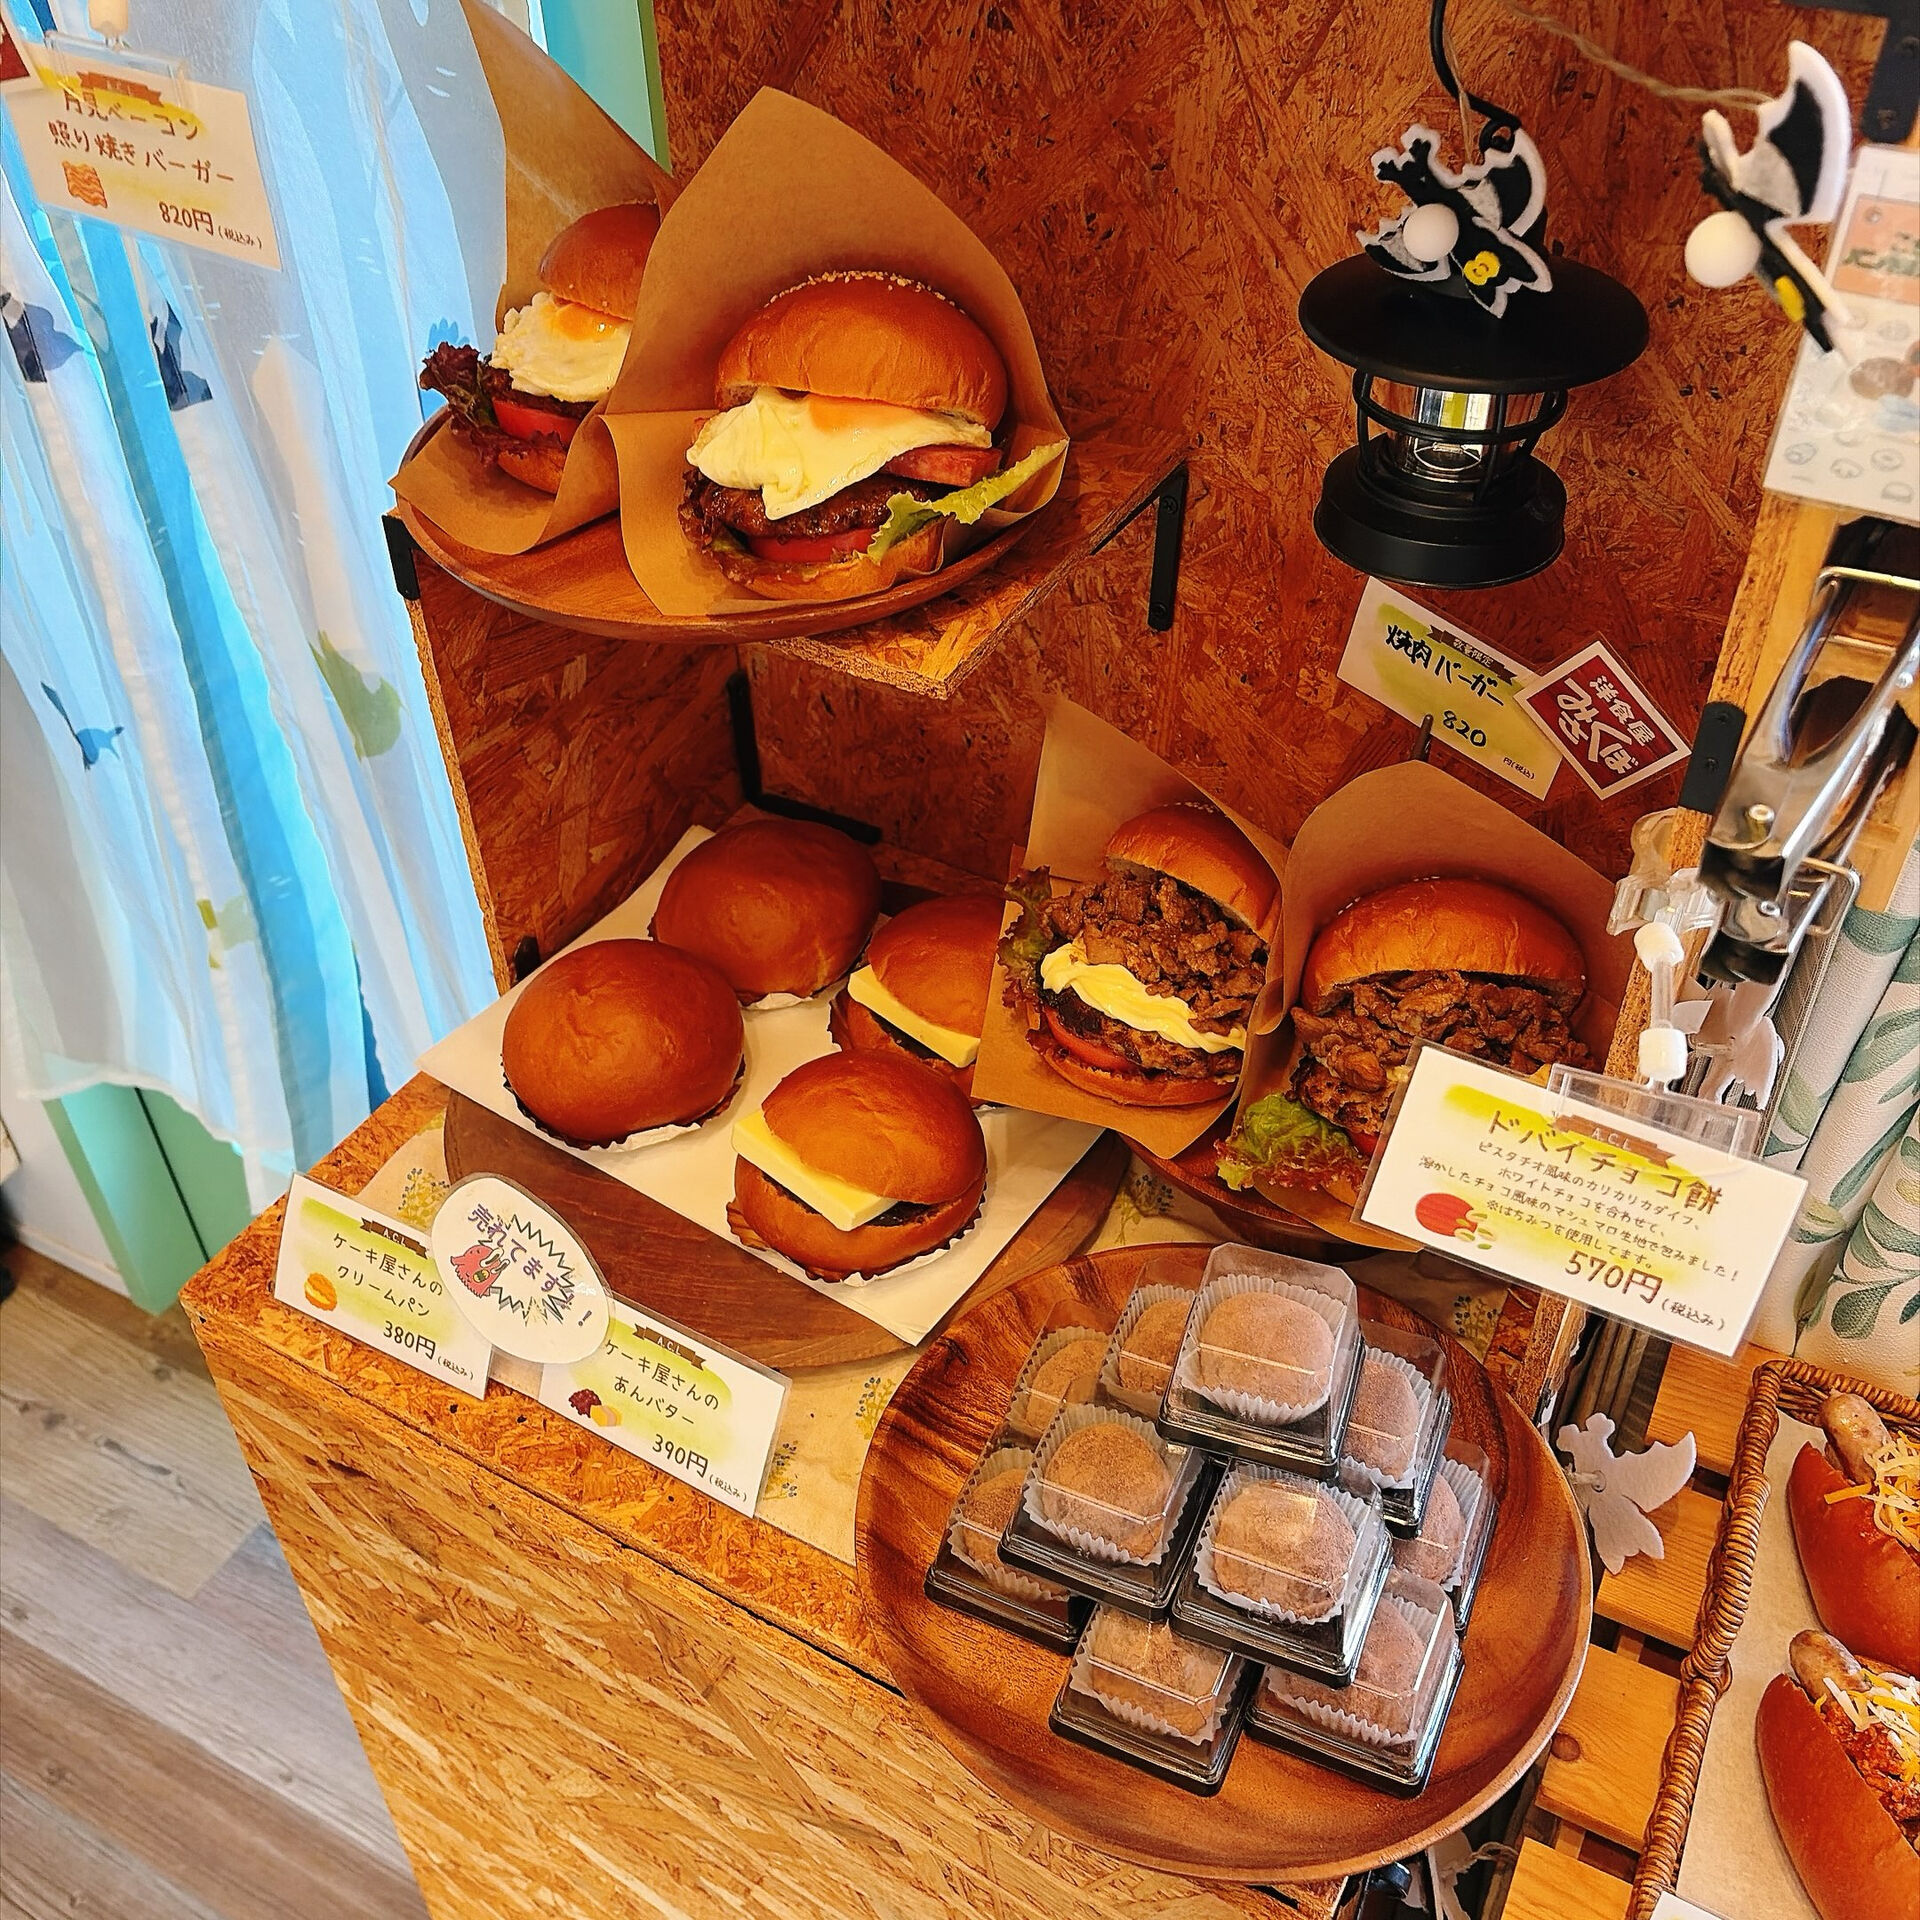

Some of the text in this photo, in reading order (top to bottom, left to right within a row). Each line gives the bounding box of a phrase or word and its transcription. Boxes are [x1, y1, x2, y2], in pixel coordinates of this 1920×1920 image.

[159, 201, 214, 236] 820円
[1385, 624, 1504, 706] 焼肉バーガー
[1440, 709, 1487, 748] 820
[1590, 675, 1656, 746] 洋食屋
[1487, 1110, 1723, 1216] ドバイチョコ餅
[1498, 1167, 1666, 1238] ホワイトチョコを合わせて、
[332, 1232, 443, 1297] ケーキ屋さんの
[1565, 1251, 1663, 1304] 570円
[336, 1265, 431, 1319] クリームパン
[382, 1319, 437, 1359] 380円
[605, 1339, 720, 1411] ケーキ屋さんの
[613, 1375, 695, 1426] あんバター
[652, 1433, 710, 1479] 390円
